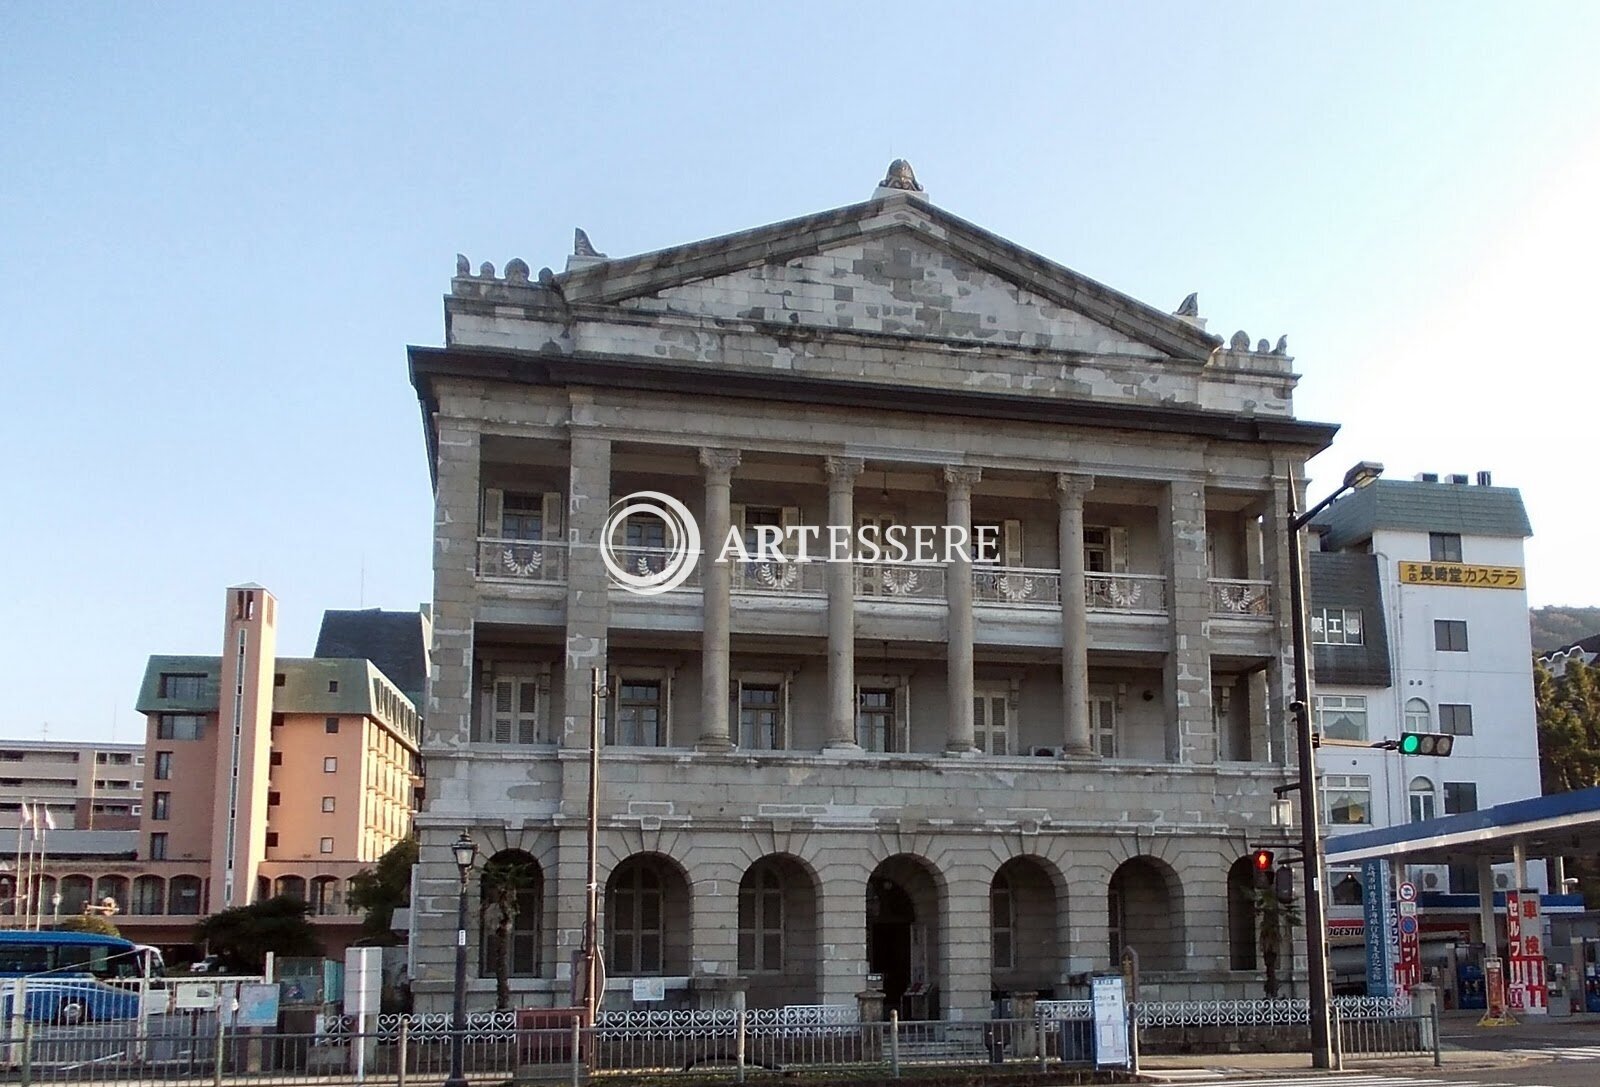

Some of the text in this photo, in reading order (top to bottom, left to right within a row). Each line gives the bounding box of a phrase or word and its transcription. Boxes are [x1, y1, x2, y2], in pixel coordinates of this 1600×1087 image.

[1420, 565, 1519, 585] 長崎堂カステラ
[1508, 899, 1520, 956] セルフ
[1523, 900, 1540, 955] 車検
